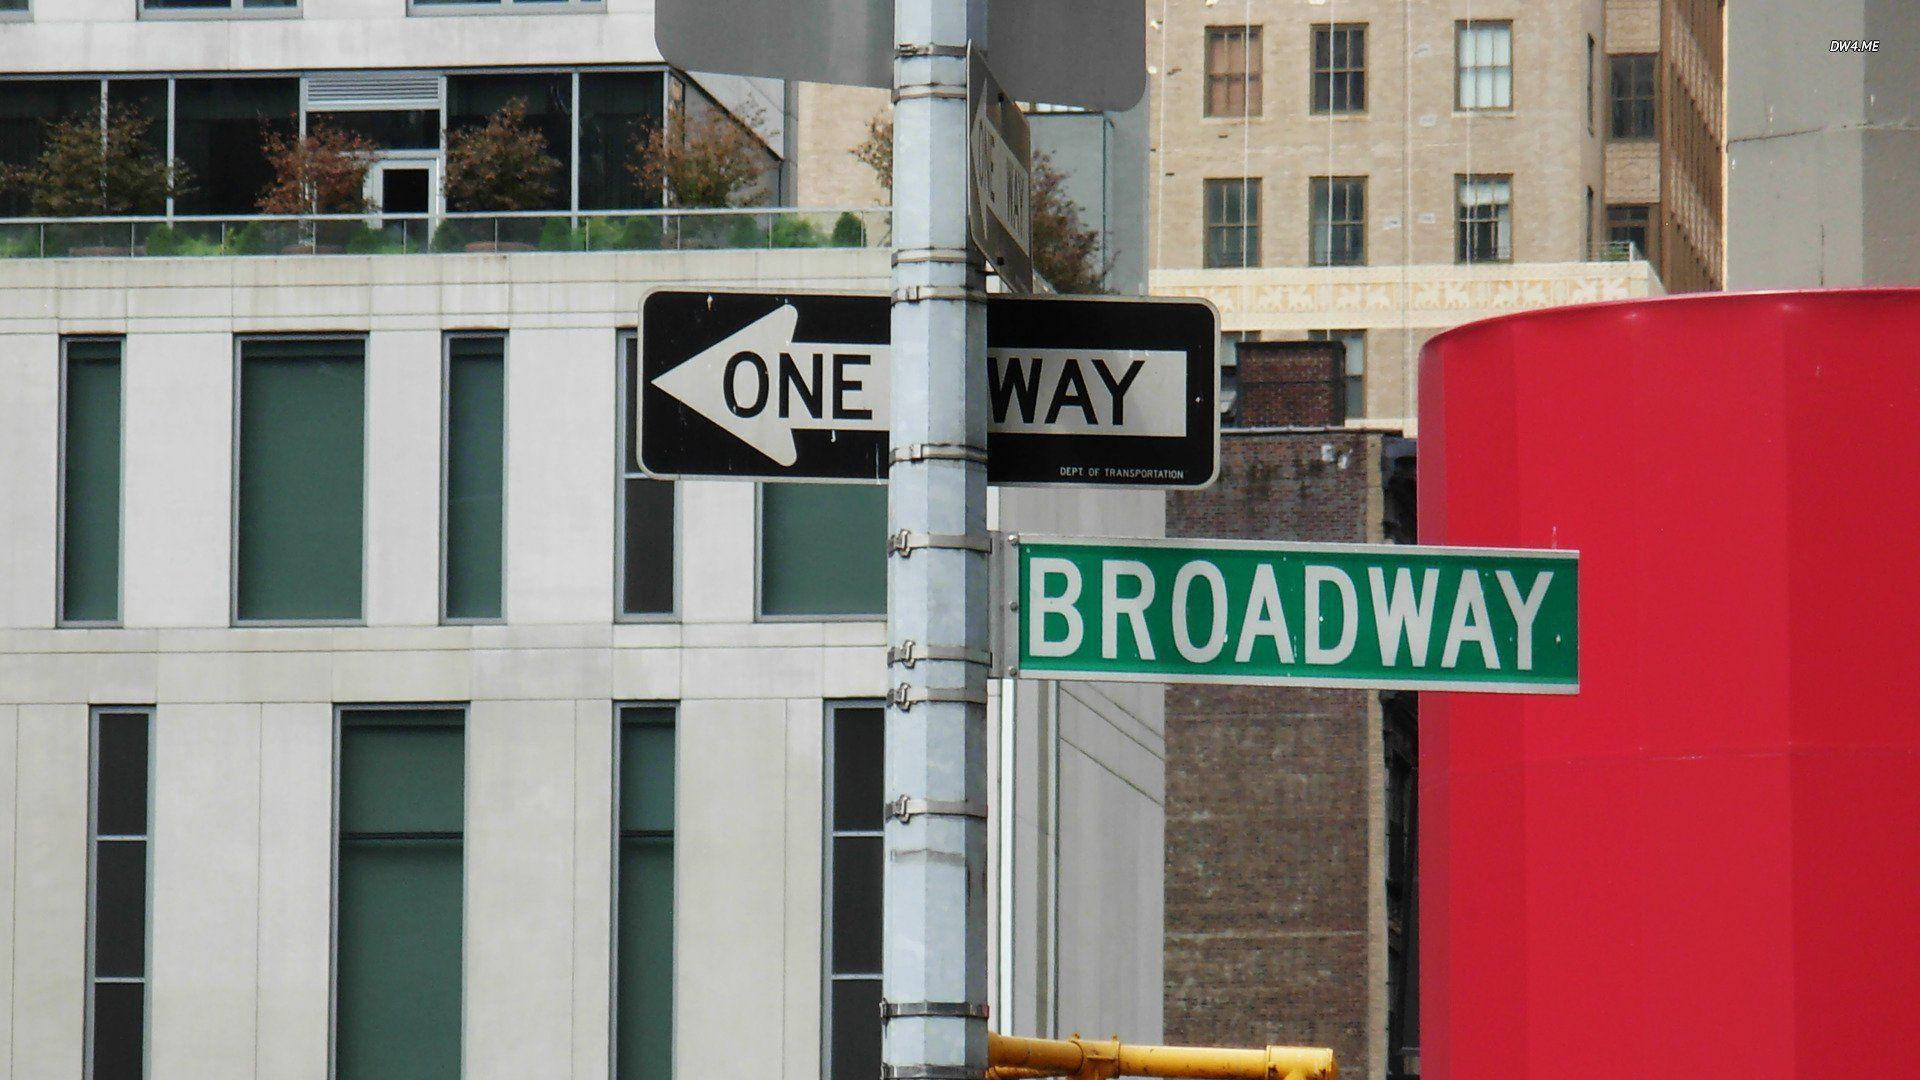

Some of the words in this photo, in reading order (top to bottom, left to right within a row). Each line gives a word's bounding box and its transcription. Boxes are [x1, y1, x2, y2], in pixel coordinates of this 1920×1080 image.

[722, 351, 873, 420] ONE
[987, 357, 1145, 426] WAY
[1088, 467, 1101, 477] OF
[1104, 467, 1184, 479] TRANSPORTATION
[1029, 557, 1555, 671] BROADWAY
